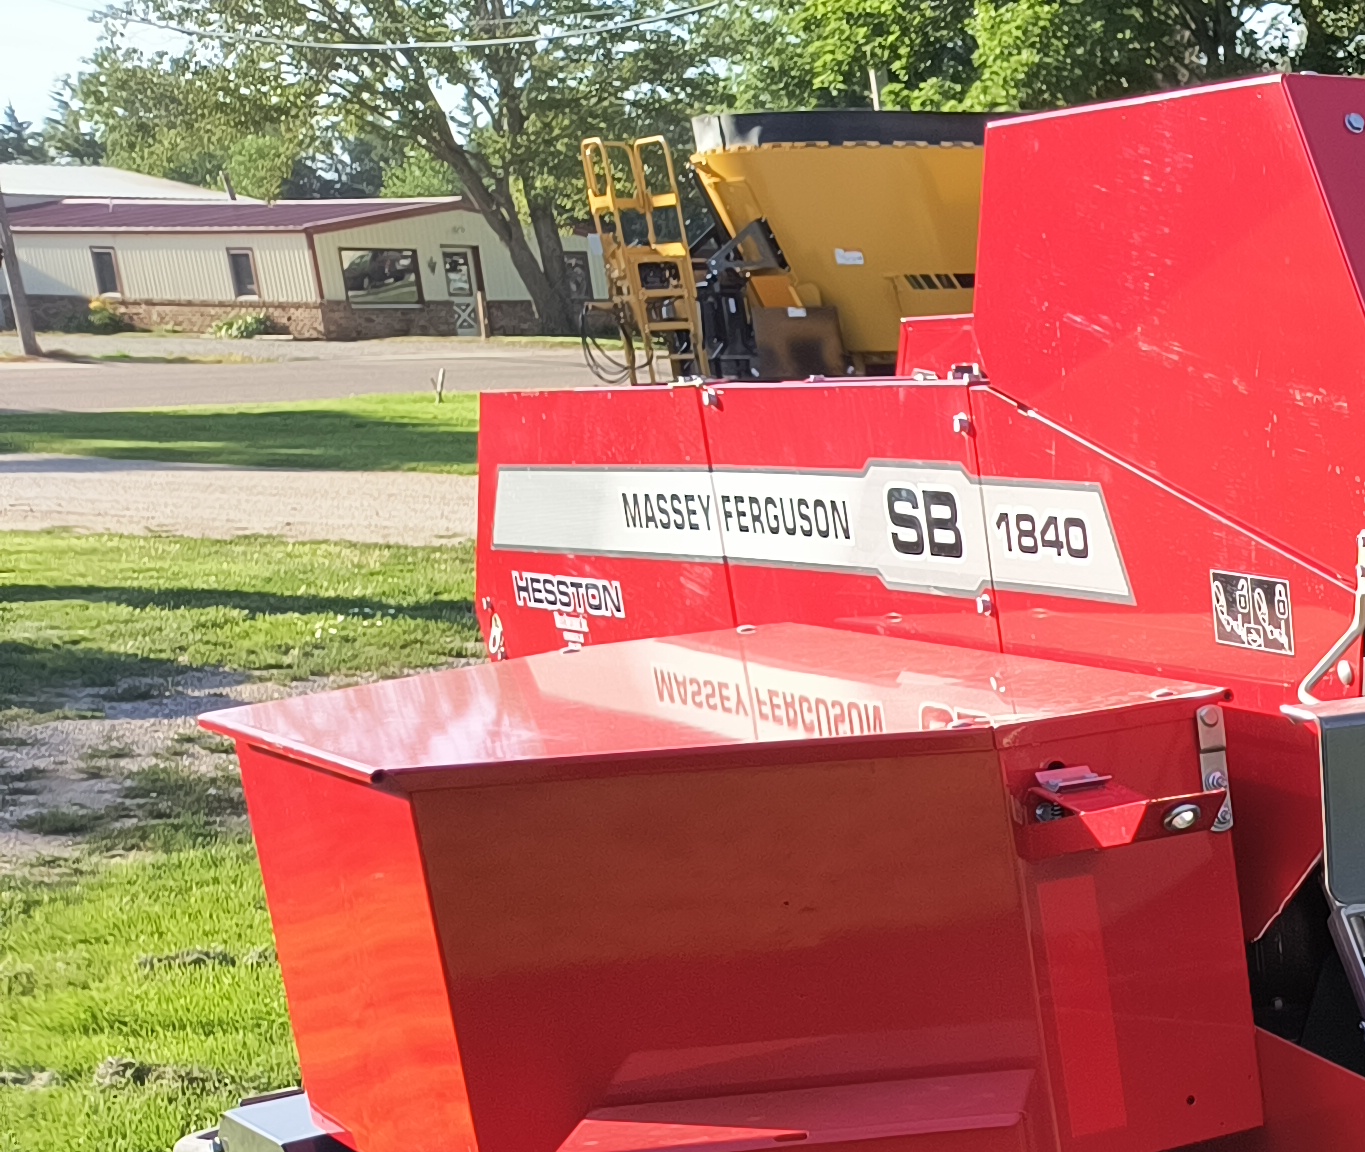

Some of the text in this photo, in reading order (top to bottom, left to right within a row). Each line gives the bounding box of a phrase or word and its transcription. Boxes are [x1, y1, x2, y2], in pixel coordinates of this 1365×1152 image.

[621, 492, 851, 540] MASSEY FERGUSON
[887, 488, 963, 558] SB
[996, 513, 1089, 559] 1840
[514, 575, 622, 613] HESSTON
